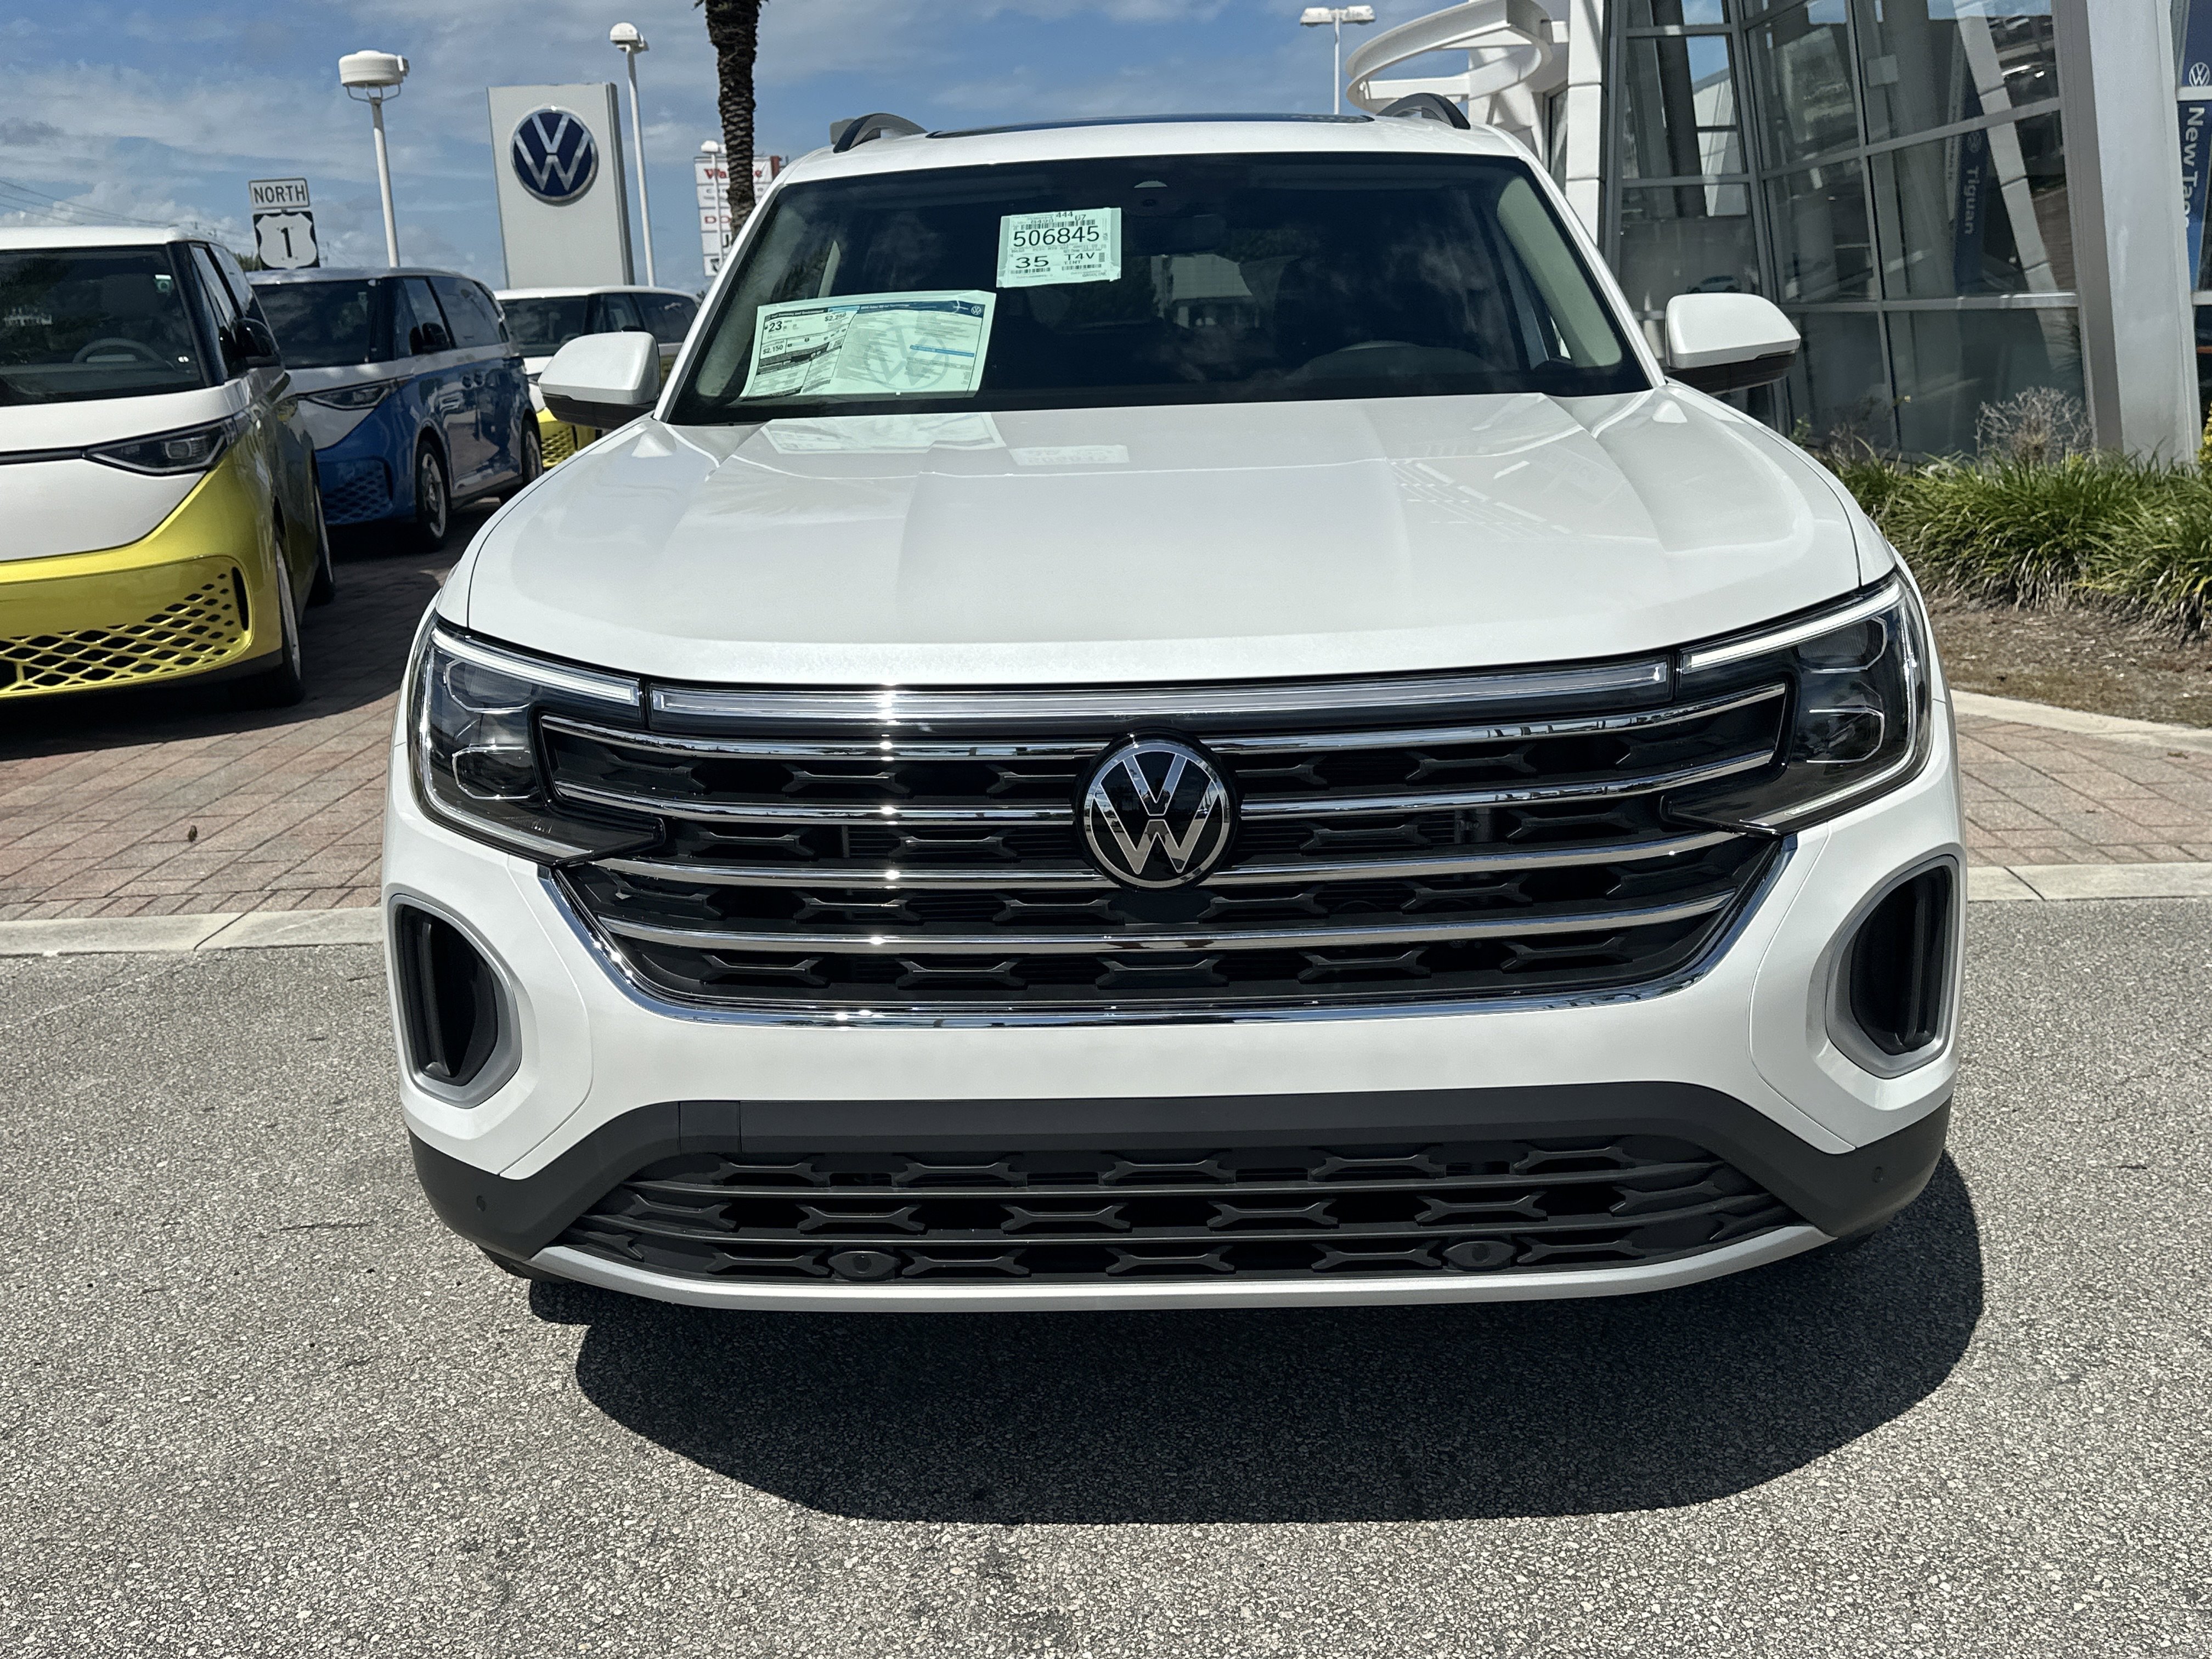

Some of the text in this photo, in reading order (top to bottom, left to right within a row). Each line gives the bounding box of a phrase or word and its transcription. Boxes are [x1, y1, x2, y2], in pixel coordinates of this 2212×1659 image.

[2183, 107, 2205, 166] New
[511, 109, 599, 203] VW
[253, 185, 307, 204] NORTH
[1963, 166, 1980, 234] Tiguan
[280, 227, 292, 258] 1
[1013, 225, 1099, 247] 506845
[1015, 255, 1049, 268] 35
[1064, 252, 1095, 261] T4V
[768, 320, 783, 333] 23
[1085, 744, 1229, 887] VW
